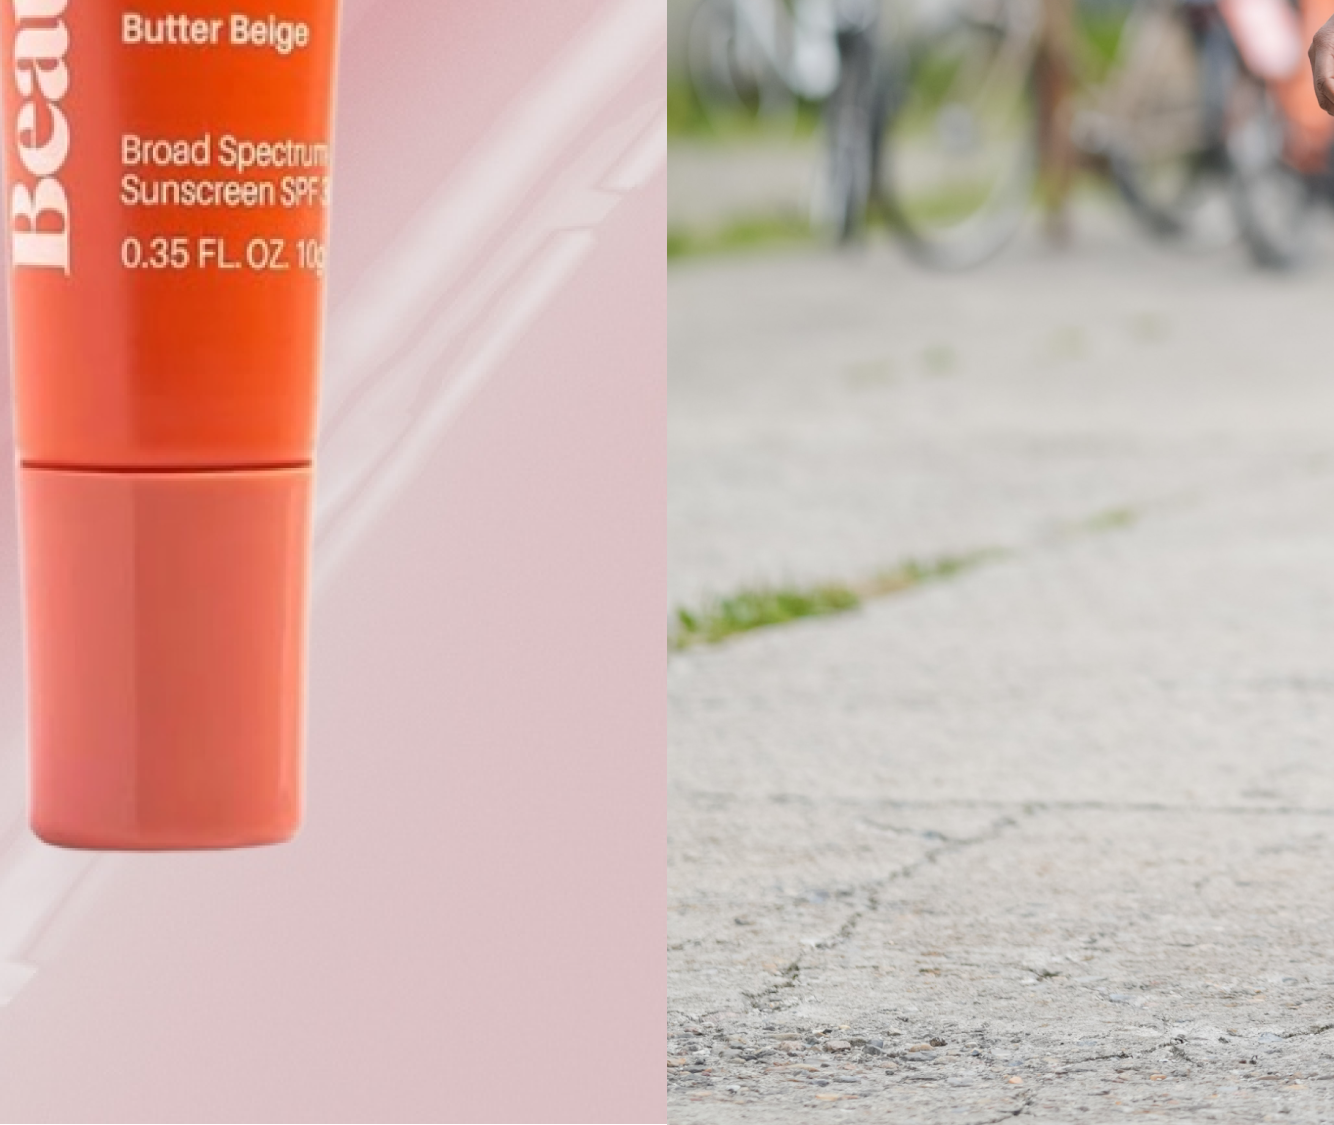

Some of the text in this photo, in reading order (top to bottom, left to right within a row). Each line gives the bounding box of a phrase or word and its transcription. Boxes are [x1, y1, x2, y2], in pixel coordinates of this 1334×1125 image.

[121, 13, 310, 54] Butter Beige
[121, 132, 211, 166] Broad
[121, 173, 275, 206] Sunscreen
[121, 237, 190, 269] 0.35
[198, 238, 242, 269] FL.
